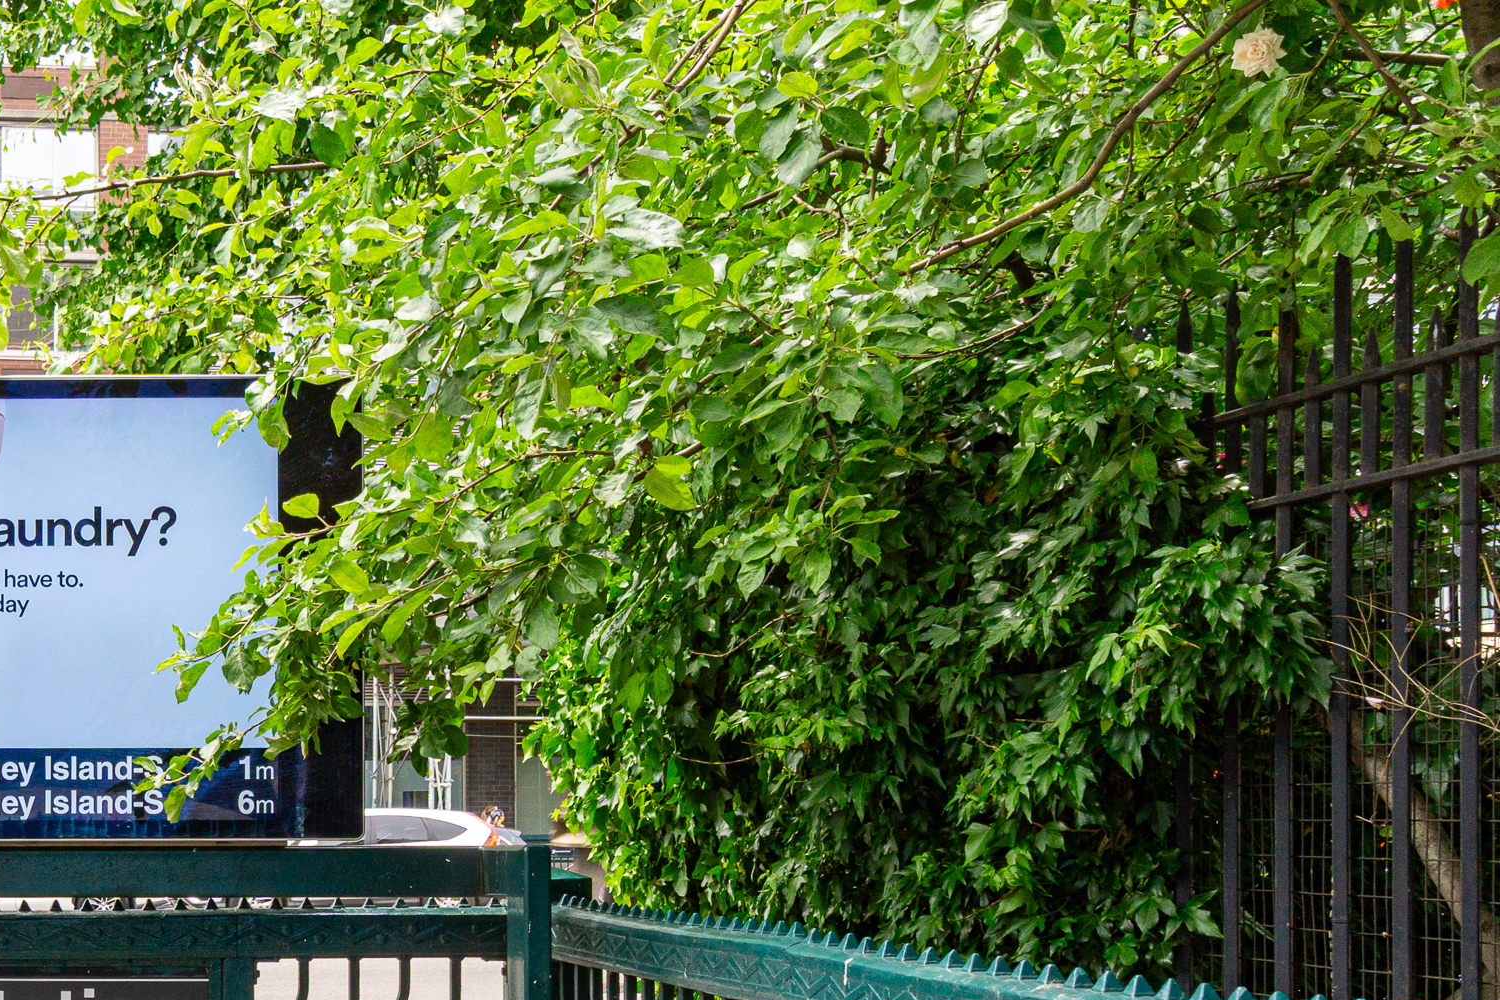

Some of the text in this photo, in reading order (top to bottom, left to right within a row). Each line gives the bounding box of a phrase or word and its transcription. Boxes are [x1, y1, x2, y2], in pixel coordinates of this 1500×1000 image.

[4, 569, 53, 589] have
[56, 570, 84, 588] to.
[238, 755, 275, 780] 1m
[238, 789, 275, 815] 6m
